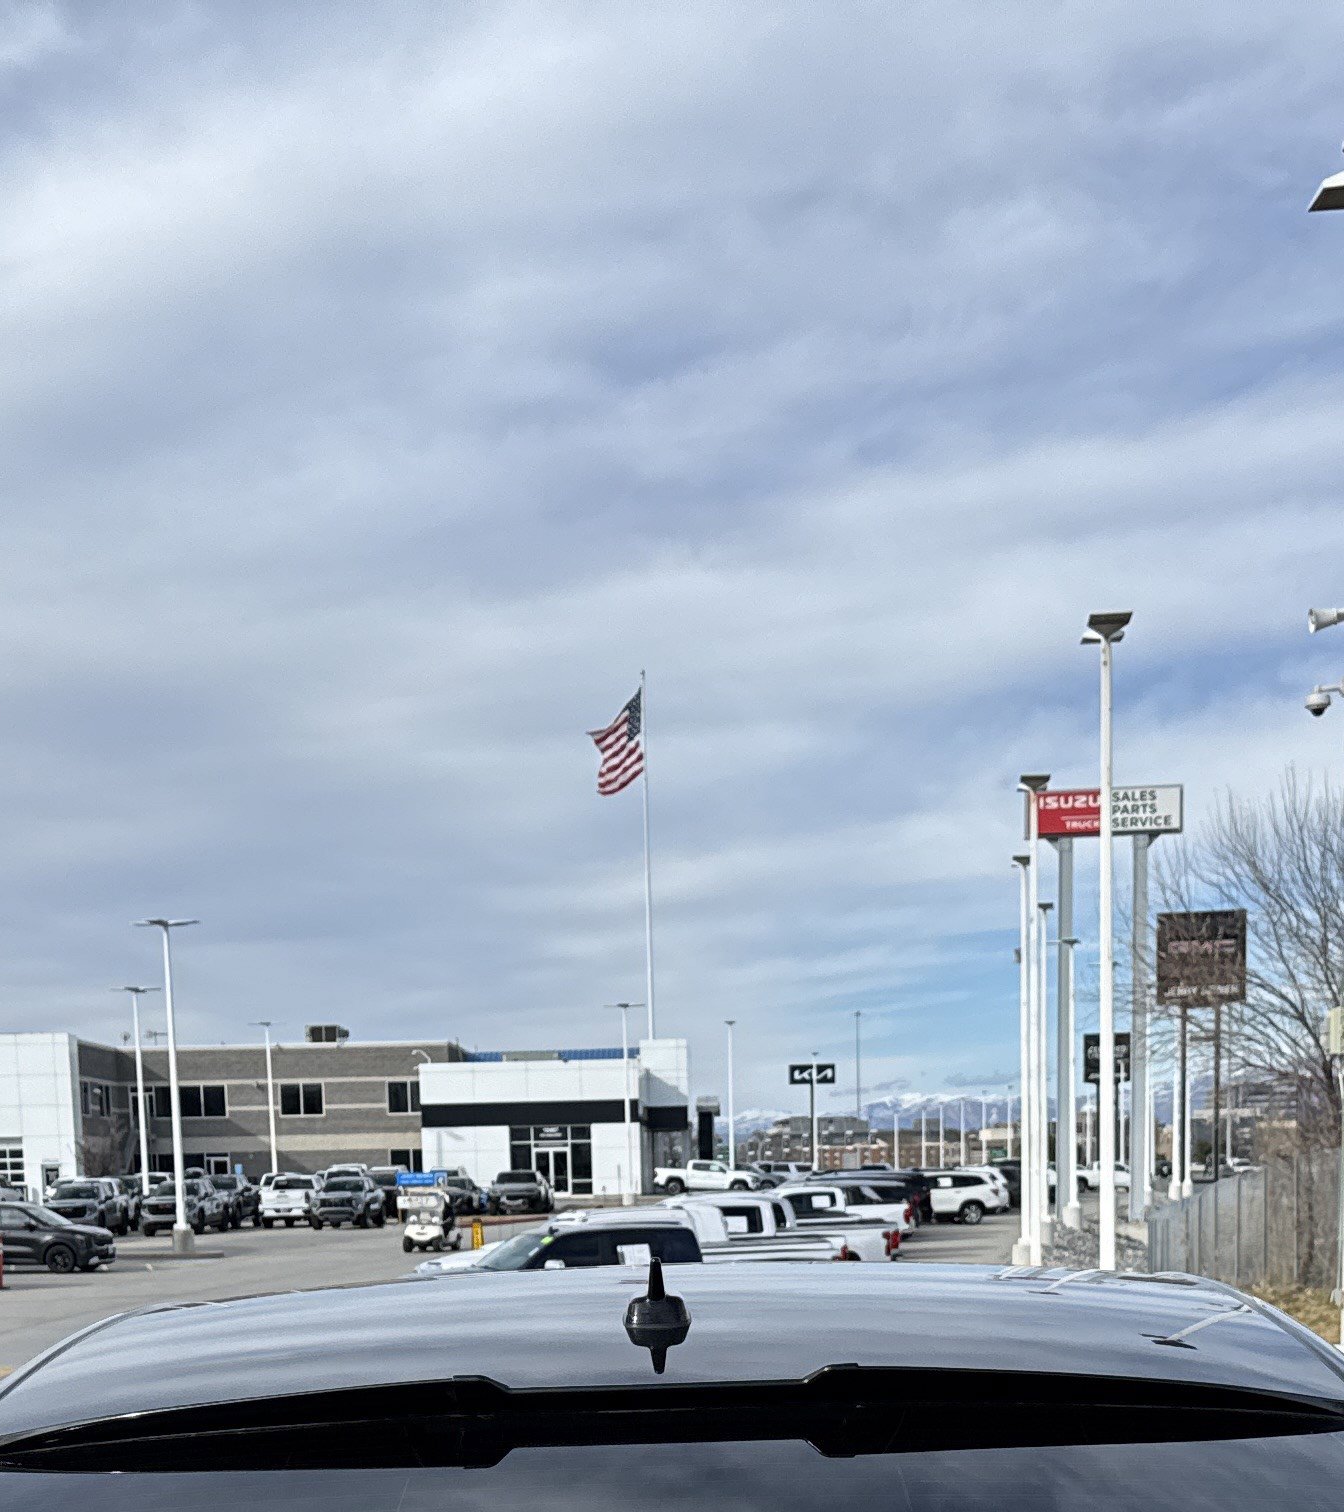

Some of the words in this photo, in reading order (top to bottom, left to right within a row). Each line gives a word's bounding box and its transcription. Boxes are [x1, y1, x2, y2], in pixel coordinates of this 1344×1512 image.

[1039, 794, 1100, 810] ISUZU
[1112, 790, 1157, 802] SALES
[1112, 803, 1157, 815] PARTS
[1112, 815, 1172, 828] SERVICE
[793, 1068, 833, 1080] KA
